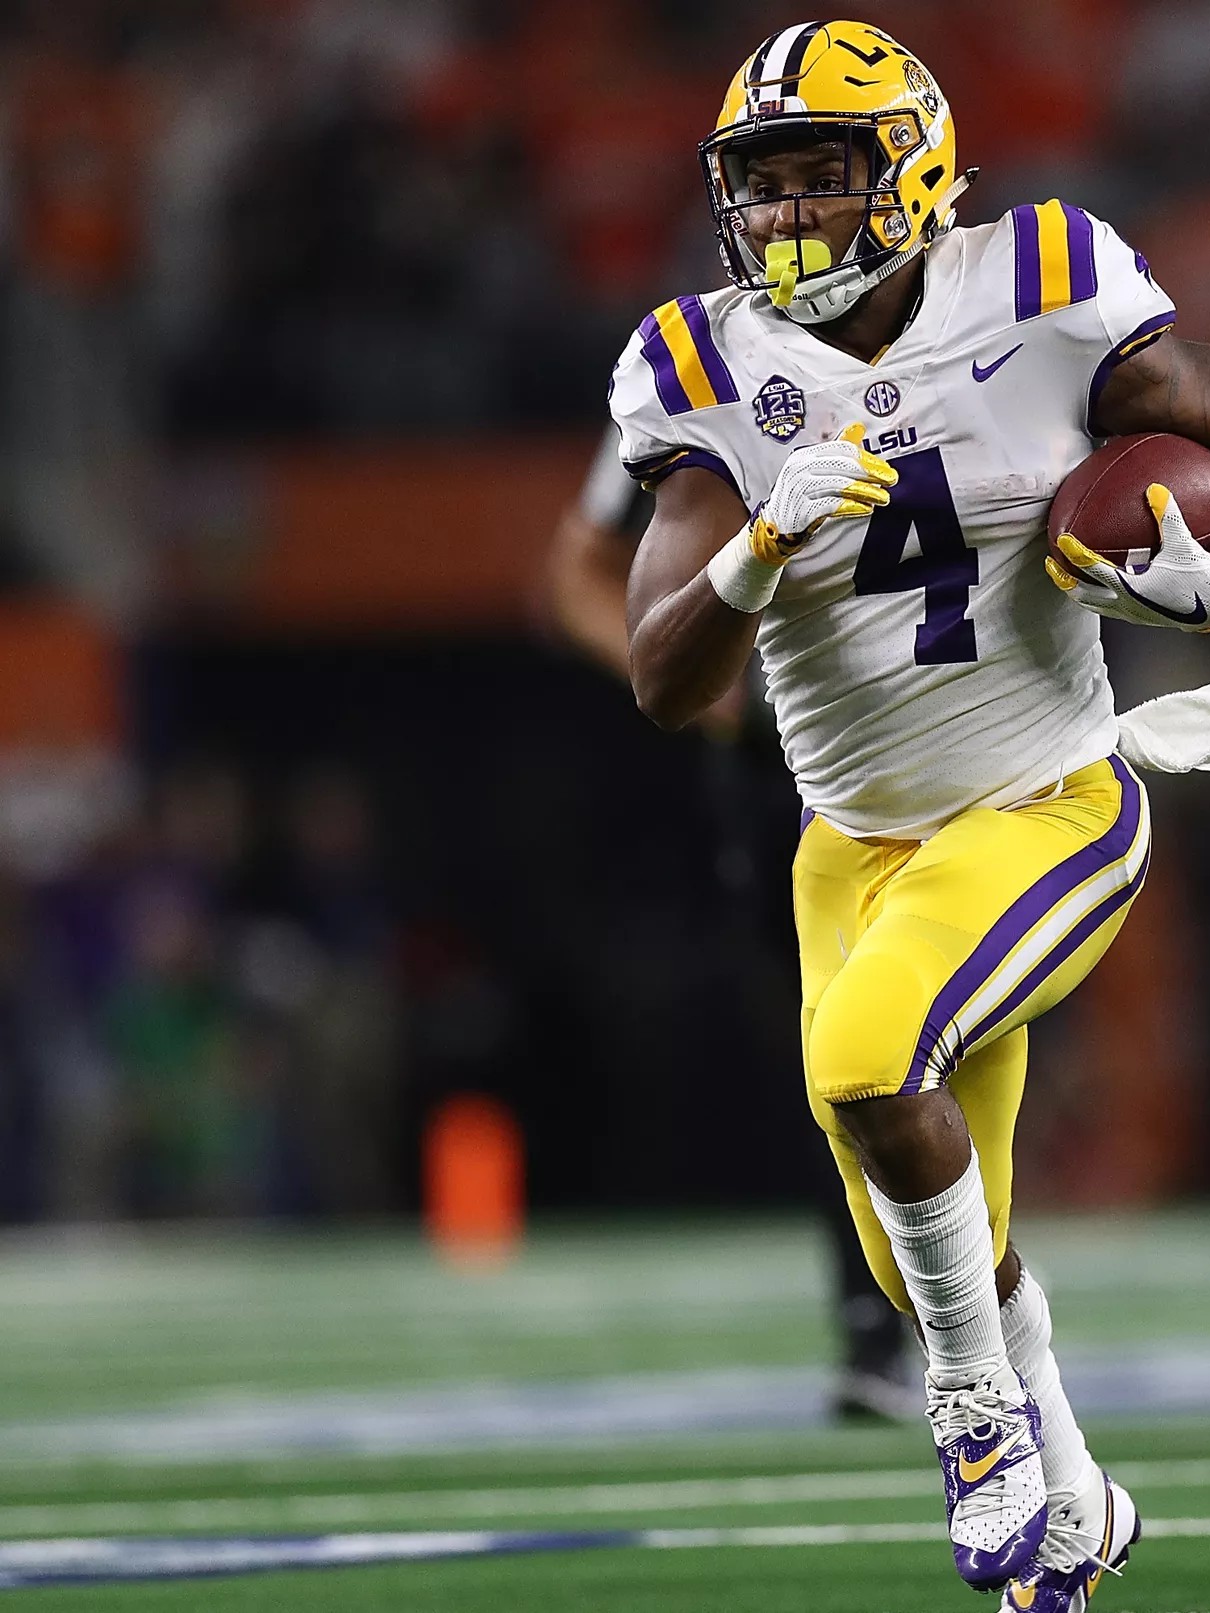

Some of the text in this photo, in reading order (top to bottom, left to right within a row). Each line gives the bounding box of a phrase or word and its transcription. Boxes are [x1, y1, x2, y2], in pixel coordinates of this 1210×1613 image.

[768, 384, 785, 392] LSU
[866, 383, 898, 414] SEC
[754, 390, 804, 422] 125
[862, 426, 918, 455] LSU
[853, 446, 978, 665] 4
